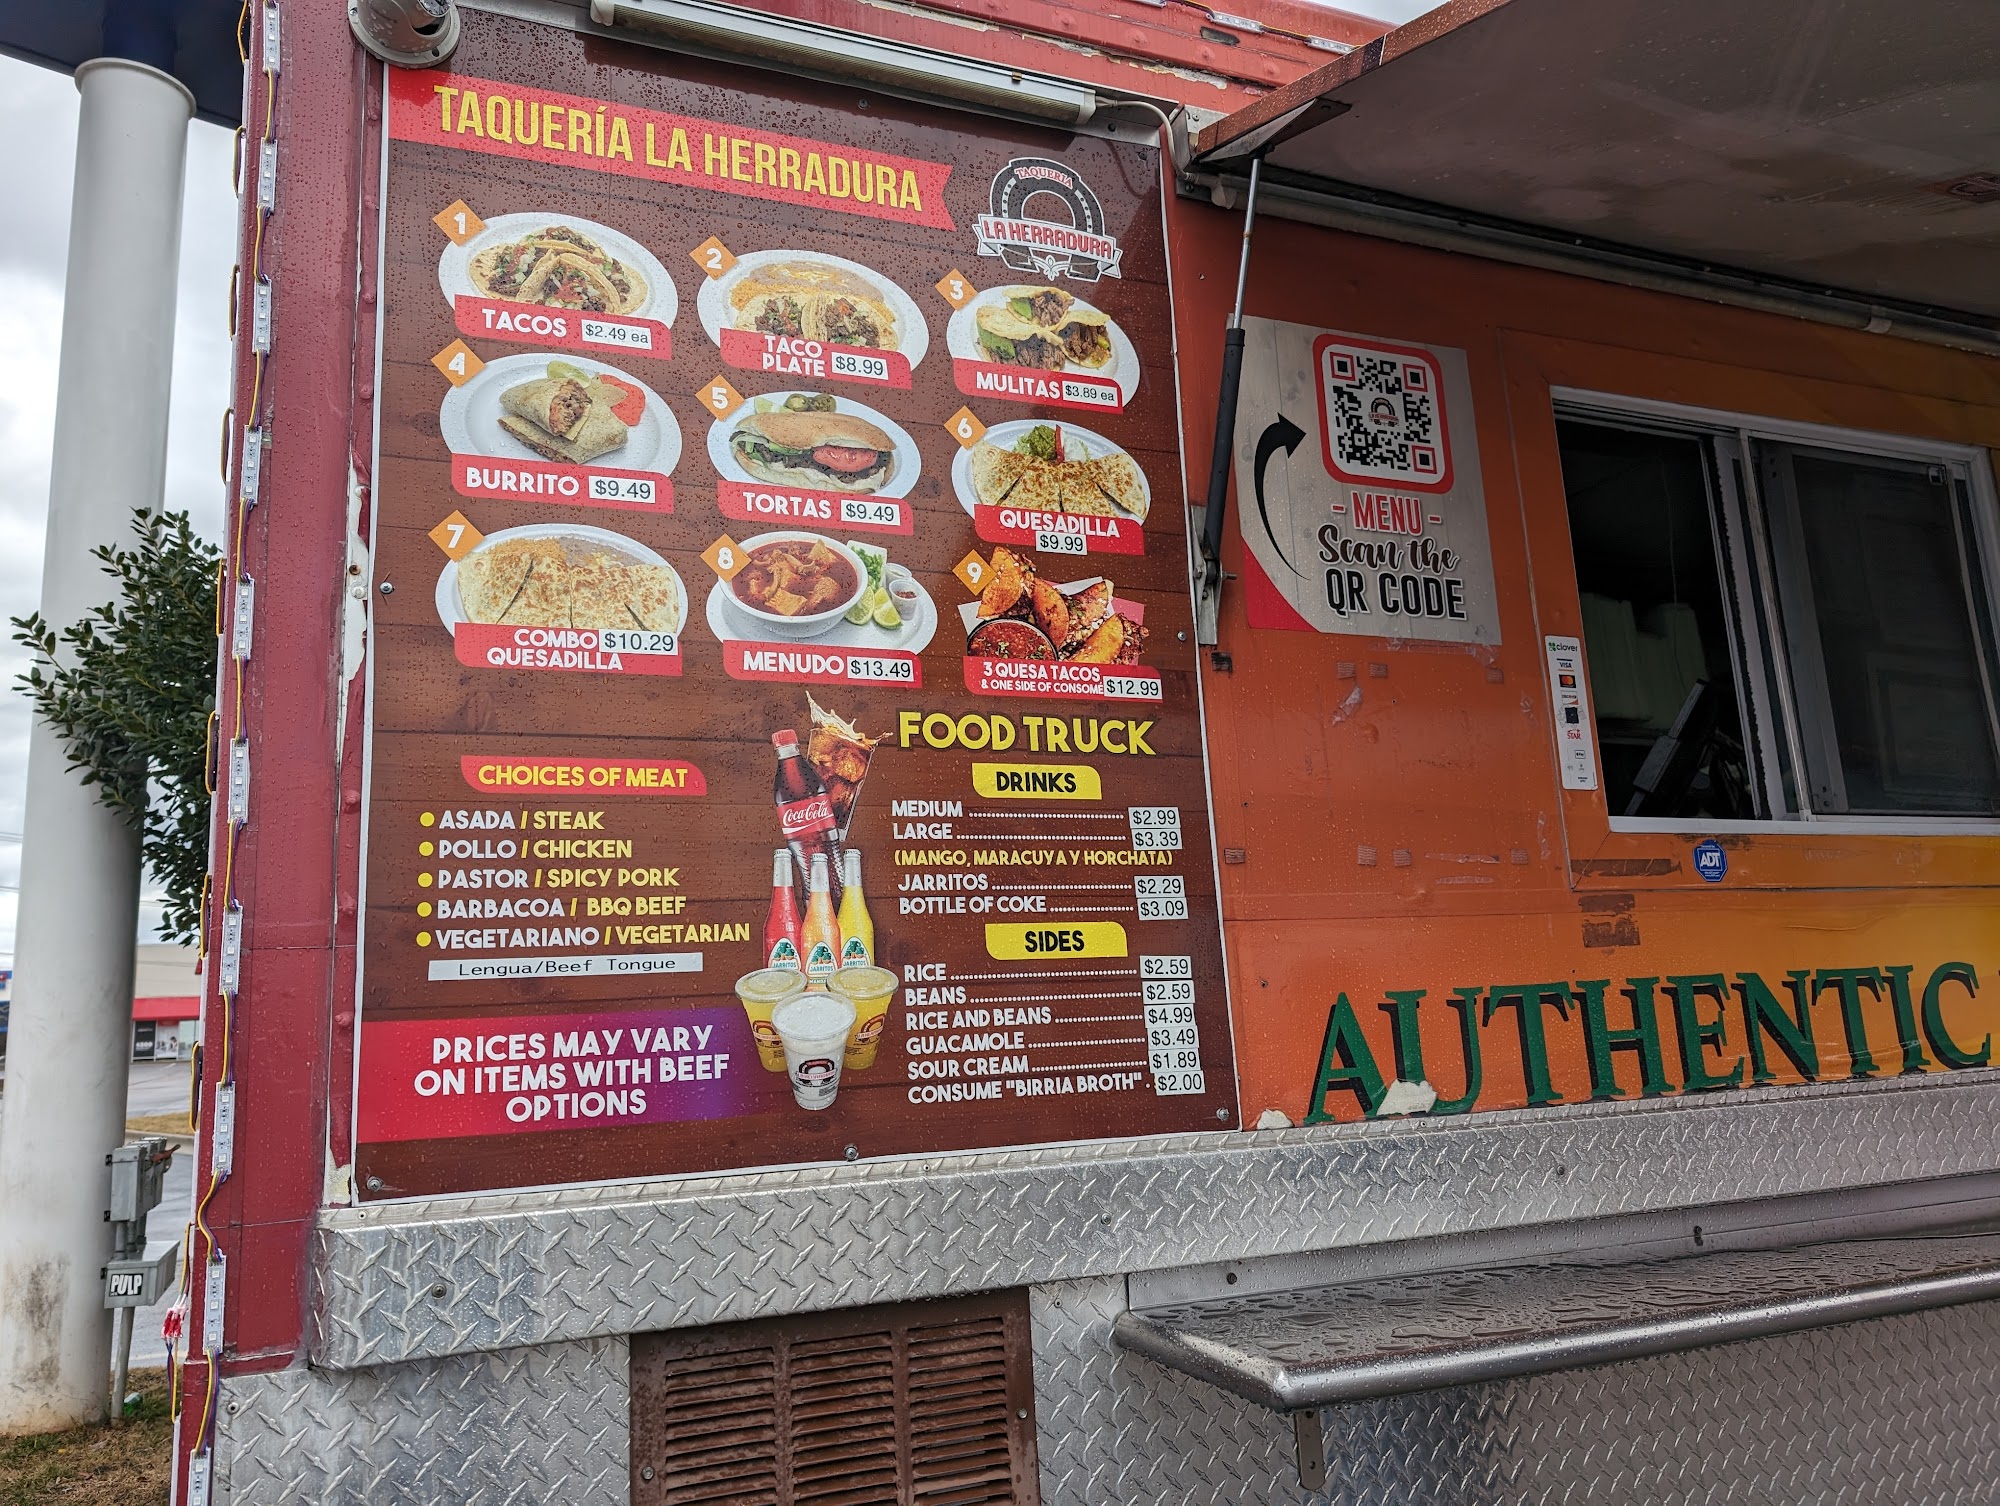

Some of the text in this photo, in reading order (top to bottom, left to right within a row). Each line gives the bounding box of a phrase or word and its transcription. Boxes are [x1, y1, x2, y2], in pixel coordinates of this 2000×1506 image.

[434, 85, 923, 212] TAQUERÍA LA HERRADURA
[1014, 166, 1073, 189] TAQUERIA
[453, 212, 466, 235] 1
[983, 220, 1113, 259] LA HERRADURA
[705, 249, 723, 270] 2
[950, 280, 963, 300] 3
[482, 308, 567, 339] TACOS
[584, 323, 649, 344] $2.49 ea
[763, 334, 823, 357] TACO
[448, 353, 465, 375] 4
[762, 352, 825, 378] PLATE
[834, 356, 884, 377] $8.99
[976, 372, 1060, 399] MULITAS
[1065, 384, 1114, 401] $3.89 ea
[712, 387, 728, 409] 5
[957, 417, 973, 439] 6
[465, 467, 580, 497] BURRITO
[594, 480, 652, 500] $9.49
[742, 491, 832, 519] TORTAS
[845, 503, 895, 522] $9.49
[1352, 491, 1422, 534] MENU
[999, 510, 1120, 538] QUESADILLA
[446, 524, 464, 549] 7
[1040, 533, 1084, 553] $9.99
[717, 547, 734, 570] 8
[1317, 523, 1458, 574] Scan the
[966, 562, 982, 584] 9
[1325, 568, 1466, 619] QR CODE
[513, 629, 598, 649] COMBO
[603, 632, 675, 653] $10.29
[1556, 643, 1578, 651] clover
[486, 646, 624, 671] QUESADILLA
[743, 650, 845, 675] MENUDO
[850, 659, 911, 679] $13.49
[983, 661, 1101, 682] 3 QUESA TACOS
[981, 679, 1104, 694] & ONE SIDE OF CONSOMÉ
[1106, 678, 1159, 697] $12.99
[899, 711, 1157, 755] FOOD TRUCK
[1567, 731, 1581, 740] STAR
[478, 765, 688, 788] CHOICES OF MEAT
[996, 771, 1077, 793] DRINKS
[891, 800, 963, 818] MEDIUM
[1132, 810, 1176, 825] $2.99
[439, 810, 516, 830] ASADA
[533, 811, 605, 830] STEAK
[893, 823, 953, 840] LARGE
[1134, 831, 1179, 847] $3.39
[438, 839, 517, 859] POLLO
[533, 839, 633, 859] CHICKEN
[894, 850, 971, 868] (MANGO,
[1069, 850, 1080, 866] Y
[1084, 850, 1173, 866] HORCHATA)
[1700, 852, 1720, 867] ADT
[438, 869, 529, 889] PASTOR
[547, 868, 613, 888] SPICY
[618, 867, 681, 887] PORK
[898, 873, 989, 892] JARRITOS
[1137, 878, 1182, 895] $2.29
[437, 898, 565, 919] BARBACOA
[586, 897, 632, 917] BBQ
[635, 896, 687, 916] BEEF
[899, 896, 1047, 915] BOTTLE OF COKE
[1140, 900, 1184, 917] $3.09
[435, 927, 599, 950] VEGETARIANO
[615, 923, 750, 945] VEGETARIAN
[1024, 930, 1085, 952] SIDES
[459, 957, 677, 977] Lengua/Beef Tongue
[904, 963, 947, 982] RICE
[1144, 959, 1189, 975] $2.59
[905, 986, 967, 1006] BEANS
[1146, 983, 1191, 1000] $2.59
[905, 1006, 1052, 1030] RICE AND BEANS
[1148, 1006, 1193, 1023] $4.99
[433, 1025, 713, 1064] PRICES MAY VARY
[906, 1031, 1025, 1055] GUACAMOLE
[1151, 1028, 1196, 1046] $3.49
[1303, 961, 1991, 1124] AUTHENTIC
[908, 1055, 1029, 1080] SOUR CREAM
[1152, 1051, 1197, 1069] $1.89
[414, 1053, 730, 1097] ON ITEMS WITH BEEF
[1158, 1074, 1202, 1092] $2.00
[908, 1072, 1142, 1105] CONSUME "BIRRIA BROTH"
[505, 1090, 647, 1123] OPTIONS
[110, 1274, 142, 1295] PULP
